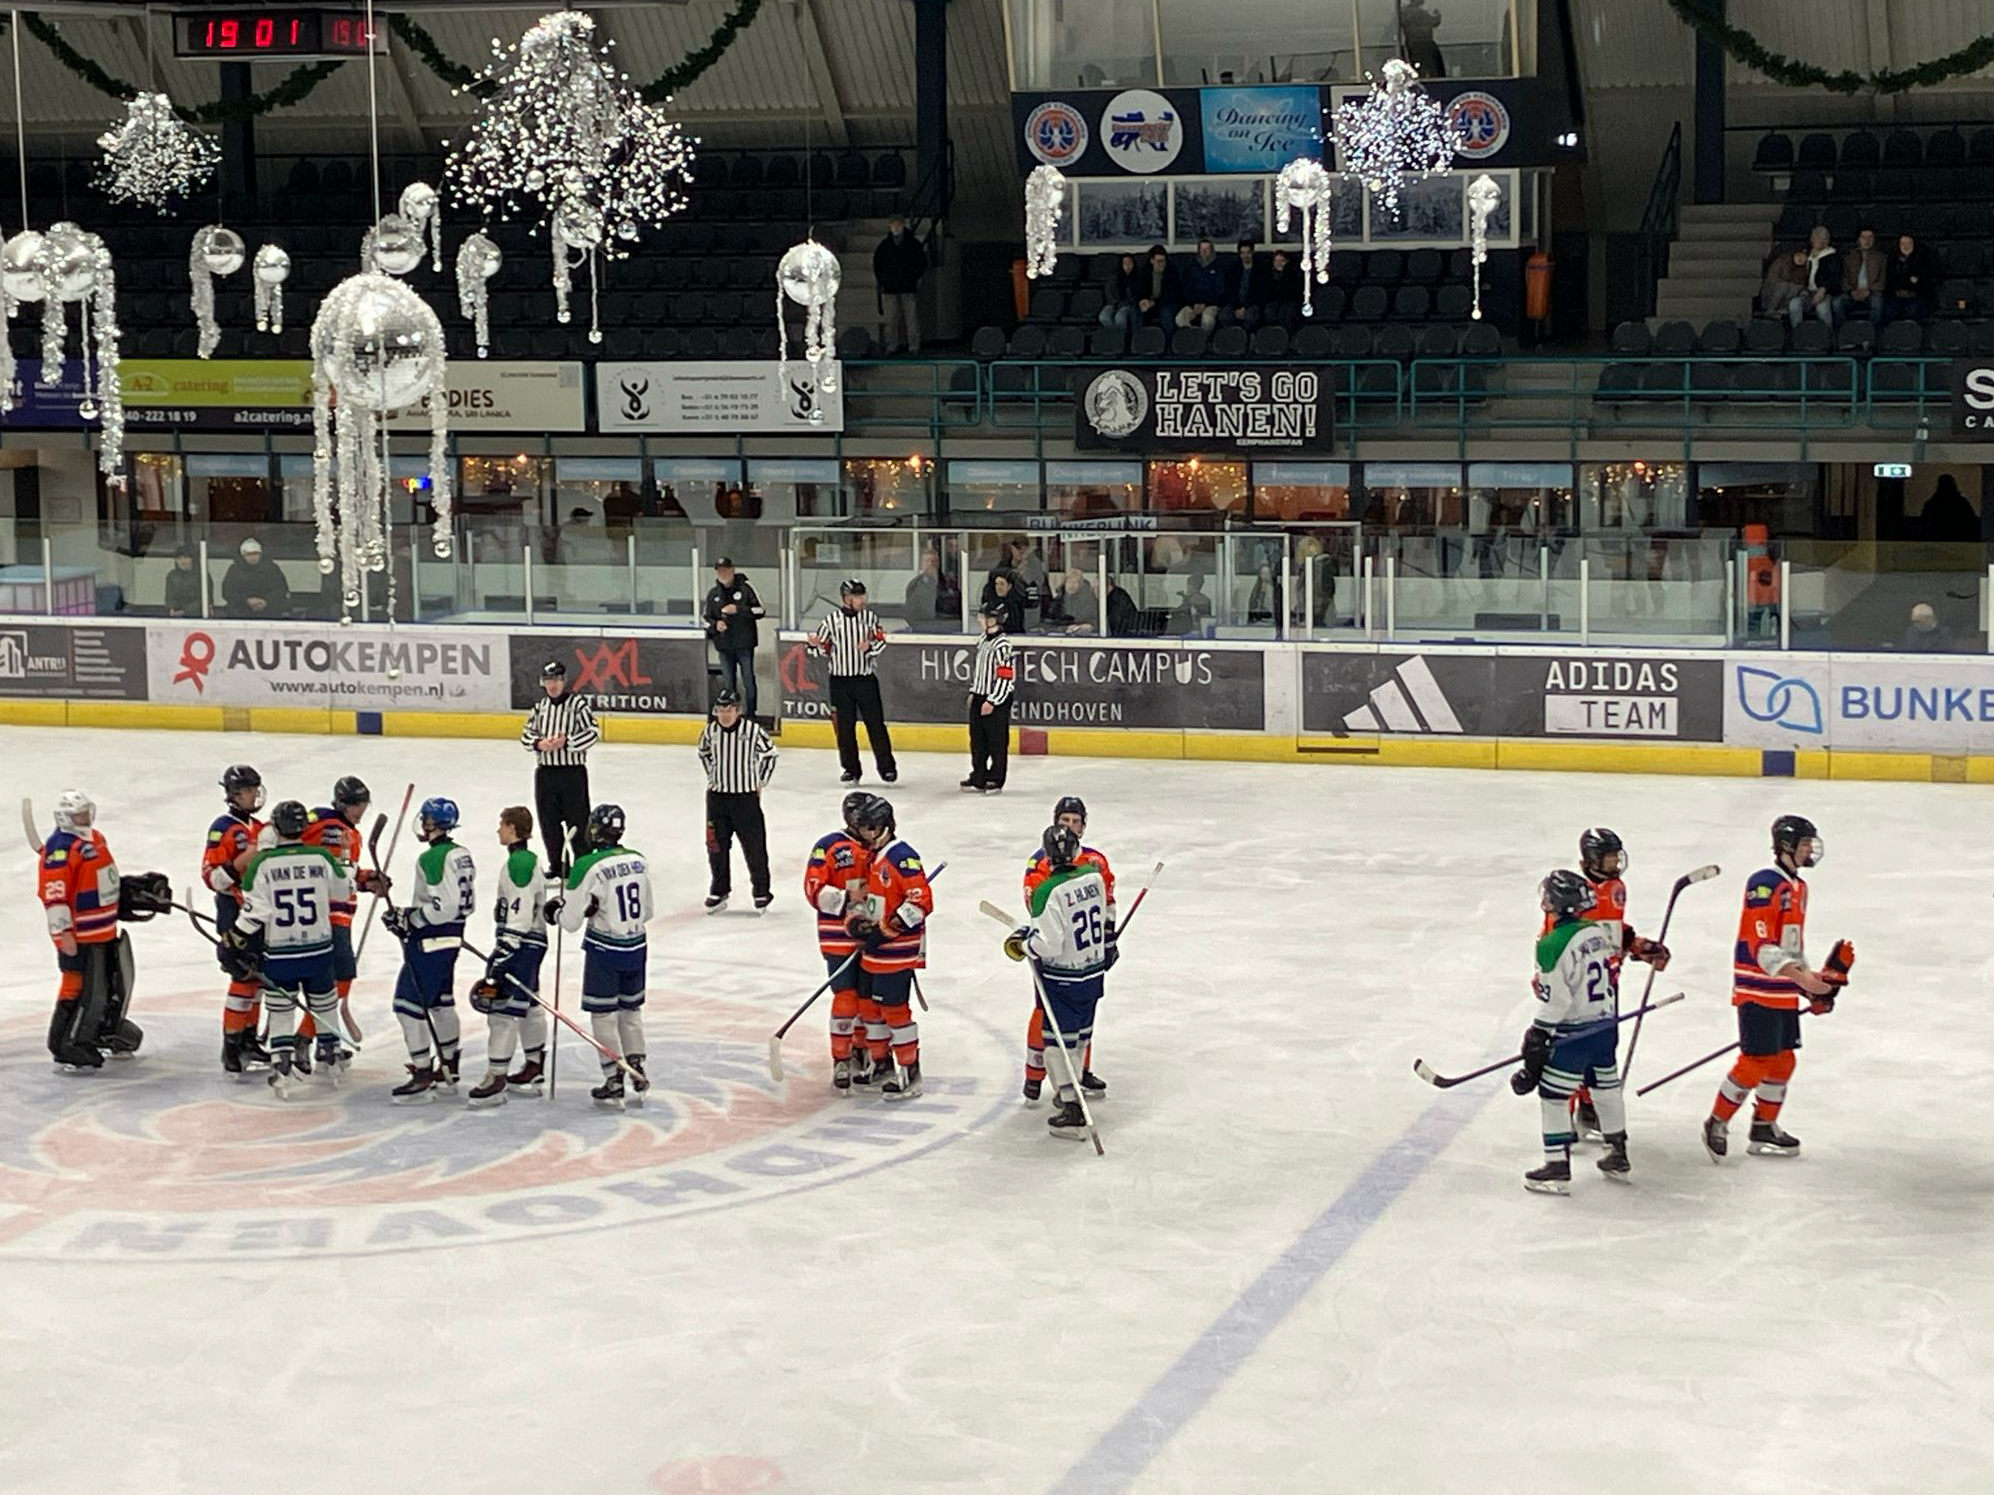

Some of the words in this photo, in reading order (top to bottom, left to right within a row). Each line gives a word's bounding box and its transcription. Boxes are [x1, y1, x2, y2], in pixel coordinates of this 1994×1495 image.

[206, 21, 239, 47] 19
[256, 19, 299, 47] 01
[1216, 106, 1307, 130] Dancing
[1228, 130, 1251, 140] on
[1249, 130, 1296, 152] Ice
[1155, 371, 1262, 403] LET'S
[1271, 371, 1319, 403] GO
[233, 409, 313, 426] a2catering.n
[1155, 403, 1318, 438] HANEN!
[227, 638, 492, 676] AUTOKEMPEN
[572, 638, 653, 694] XXL
[921, 649, 971, 681] HIG
[1089, 651, 1212, 686] CAMPUS
[269, 679, 445, 699] www.autokempen.nl
[1545, 660, 1679, 693] ADIDAS
[1010, 700, 1122, 722] EINDHOVEN
[1580, 699, 1667, 731] TEAM
[1841, 685, 1994, 723] BUNKE
[273, 886, 318, 928] 55
[615, 881, 641, 922] 18
[1072, 905, 1102, 951] 26
